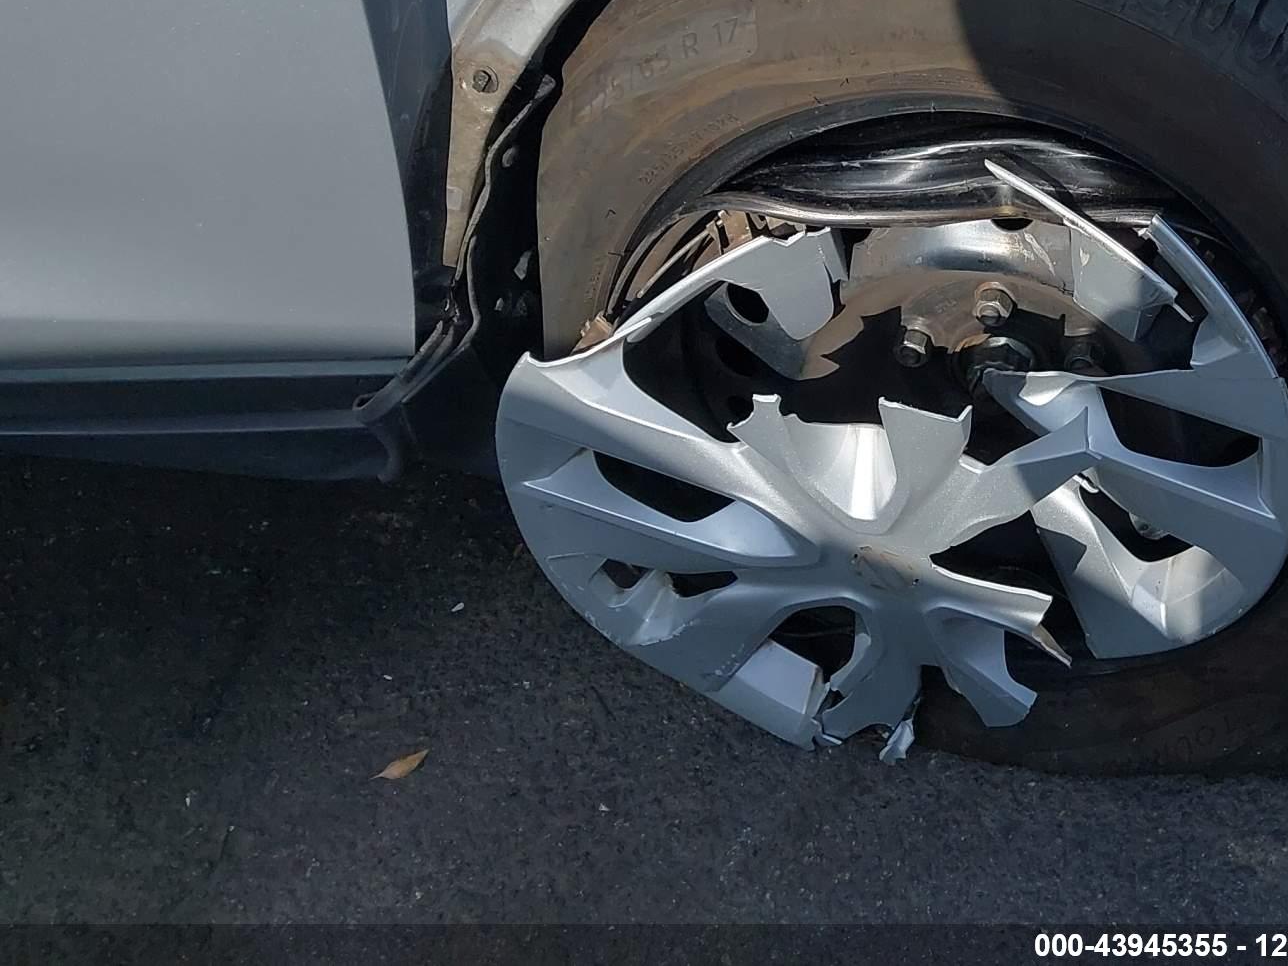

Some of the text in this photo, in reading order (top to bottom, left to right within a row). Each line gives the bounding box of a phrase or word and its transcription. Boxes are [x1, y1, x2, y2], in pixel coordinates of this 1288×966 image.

[575, 17, 740, 123] 5/65 R 17
